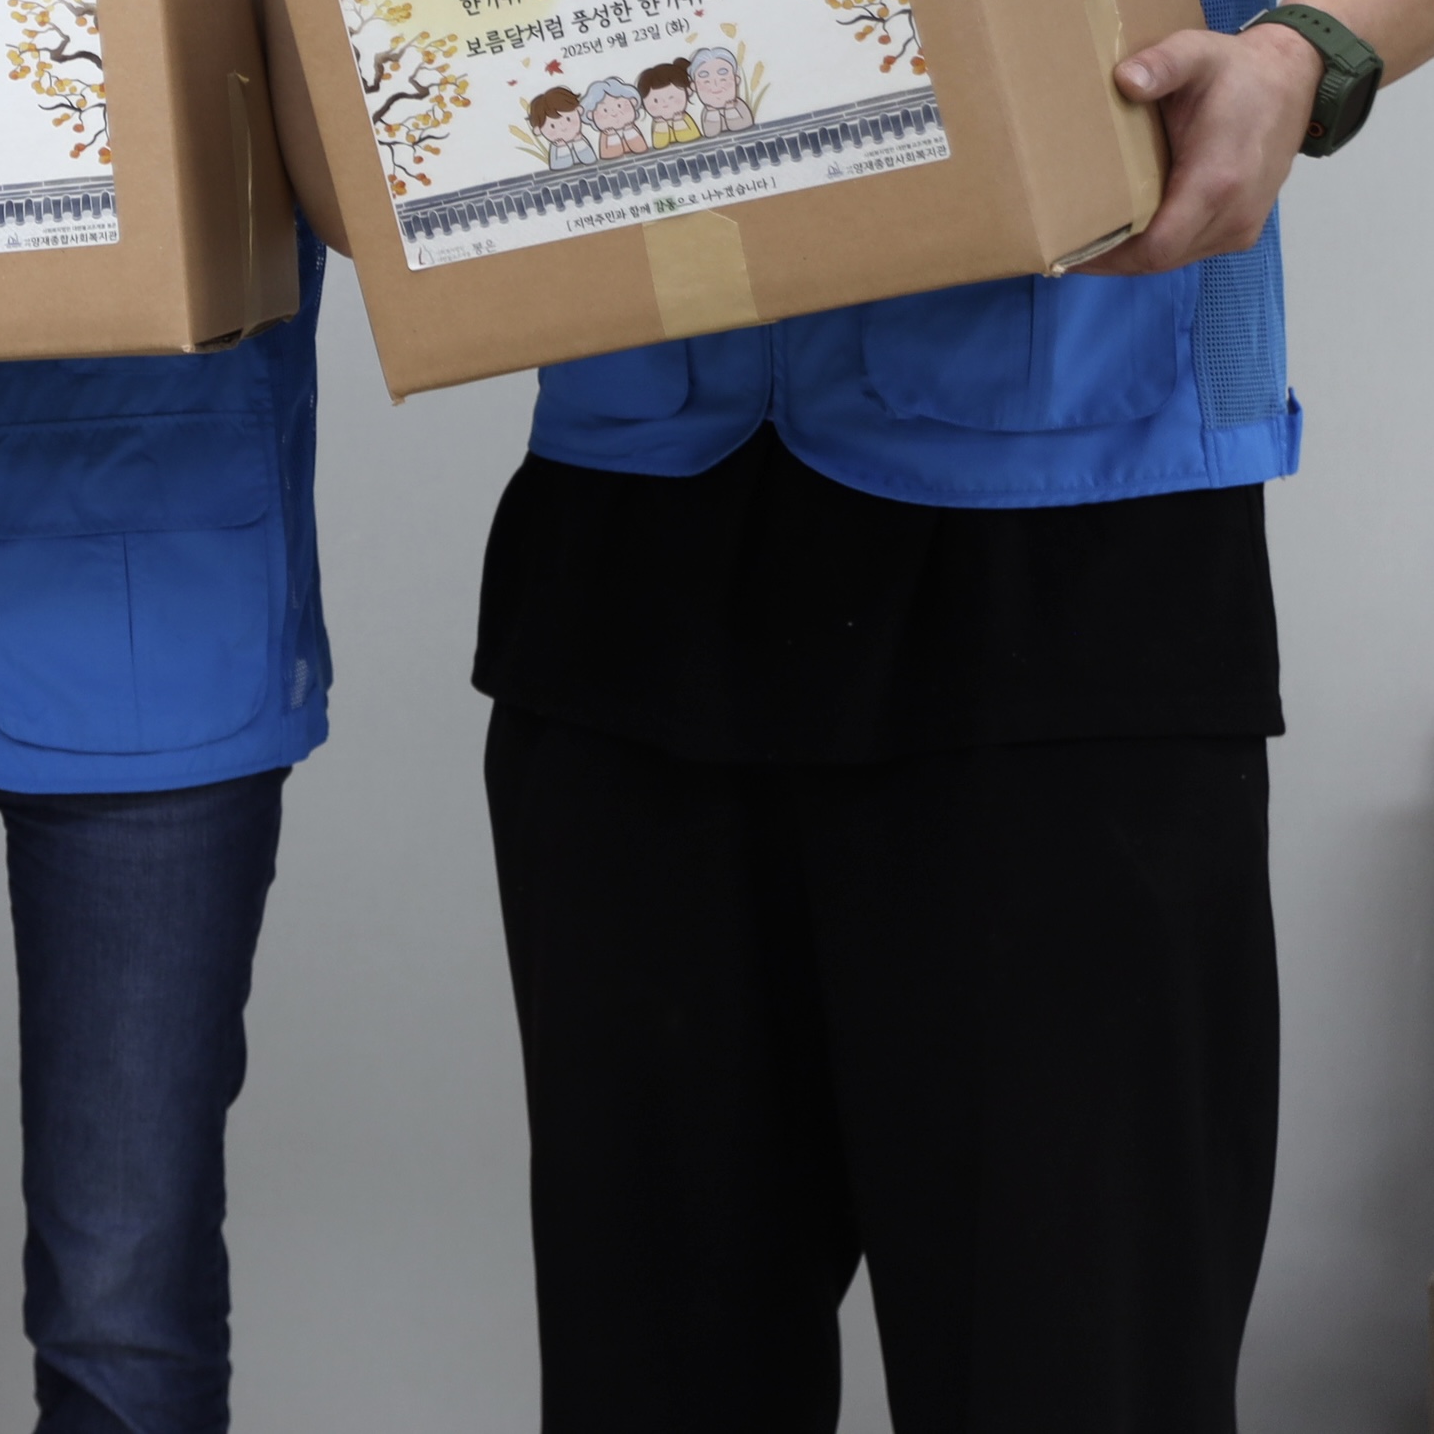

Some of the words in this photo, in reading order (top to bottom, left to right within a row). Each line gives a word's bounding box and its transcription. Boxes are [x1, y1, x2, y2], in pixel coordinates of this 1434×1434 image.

[466, 15, 565, 57] 보름달처럼
[571, 0, 633, 34] 풍성한
[561, 37, 603, 59] 2025년
[606, 31, 628, 48] 9월
[632, 24, 661, 42] 23일
[665, 18, 690, 36] (화)
[574, 208, 627, 229] 지역주민과
[629, 202, 651, 219] 함께
[654, 194, 699, 213] 감동으로
[701, 178, 768, 202] 나누겠습니다
